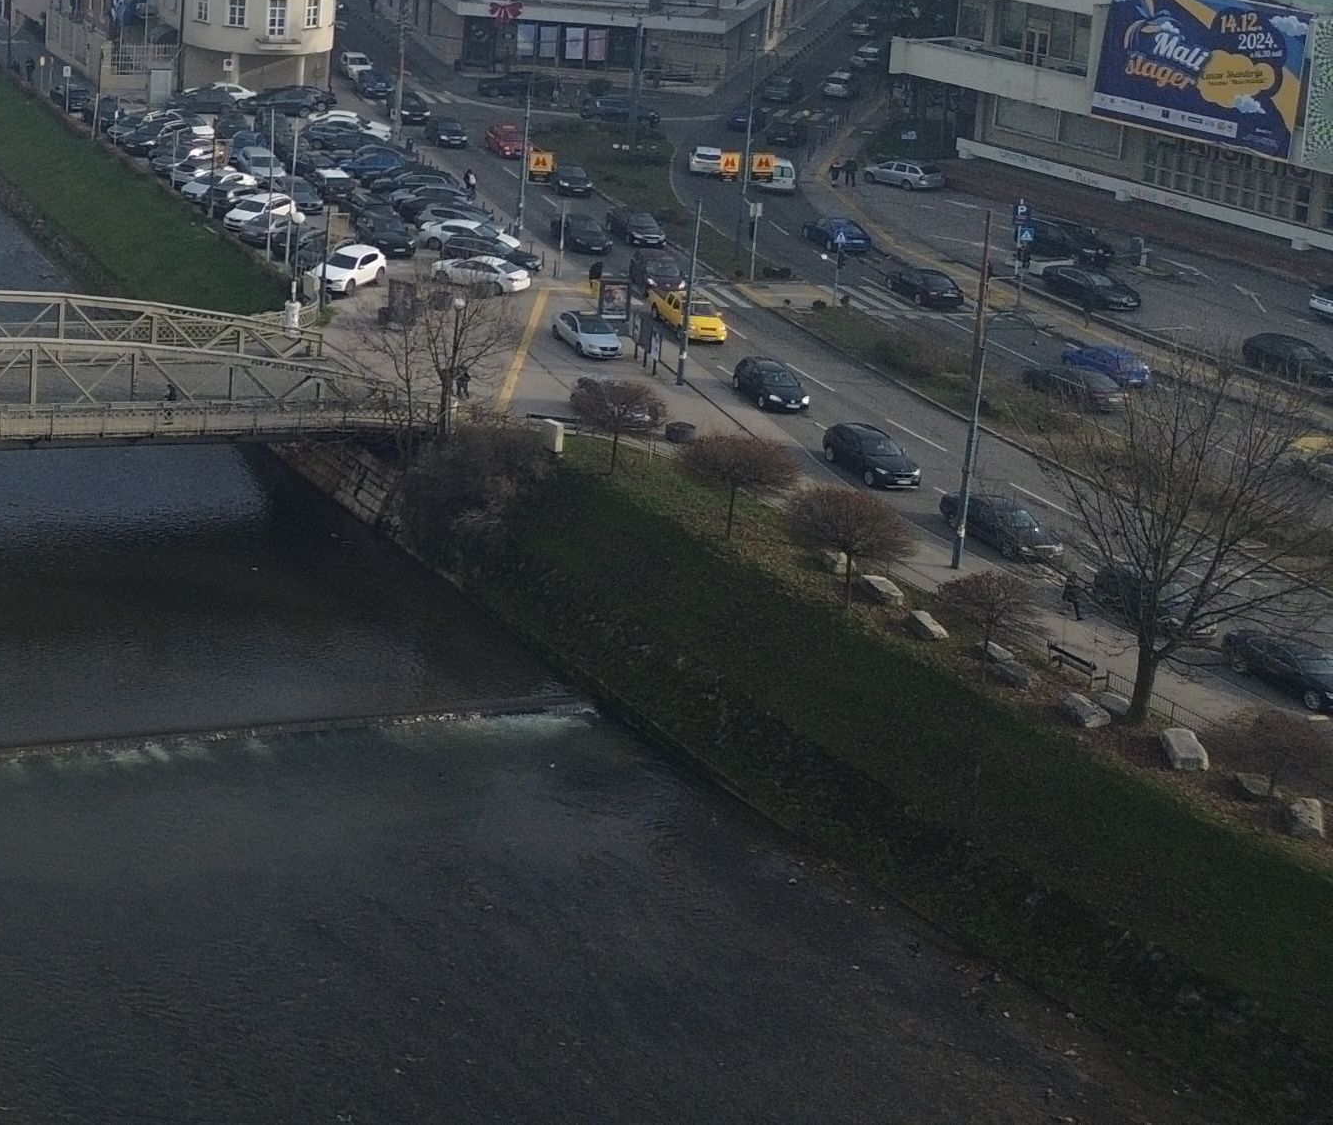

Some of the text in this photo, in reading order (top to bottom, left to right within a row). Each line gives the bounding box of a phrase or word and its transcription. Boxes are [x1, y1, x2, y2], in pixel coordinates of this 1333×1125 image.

[1220, 12, 1263, 33] 14.12.
[1238, 32, 1278, 50] 2024.
[1153, 31, 1209, 72] Mali
[1017, 205, 1027, 216] P
